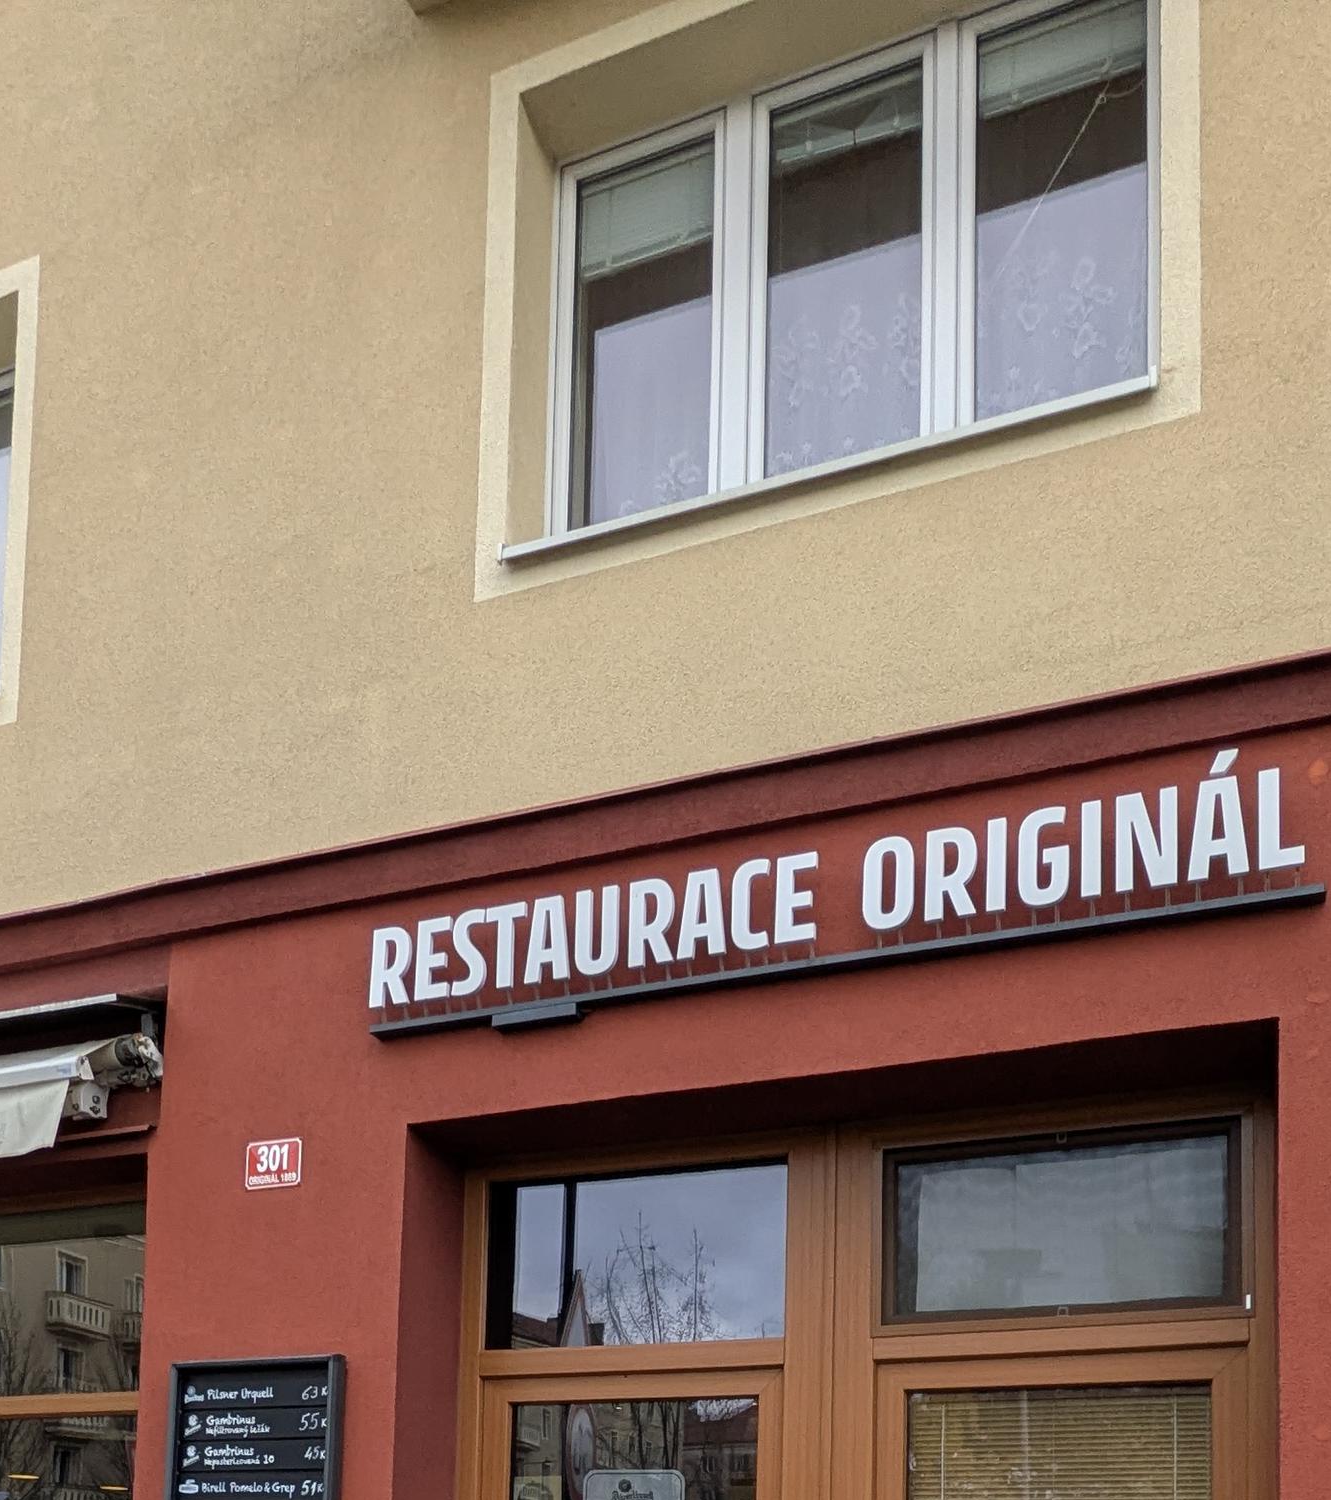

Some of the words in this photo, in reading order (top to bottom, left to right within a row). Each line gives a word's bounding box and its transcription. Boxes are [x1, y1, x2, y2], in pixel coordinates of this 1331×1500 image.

[369, 851, 819, 1008] RESTAURACE
[861, 748, 1306, 933] ORIGINÁL
[256, 1144, 289, 1172] 301
[206, 1388, 239, 1400] Pilsner
[241, 1386, 274, 1404] Urquell
[301, 1386, 319, 1400] 63
[205, 1412, 256, 1426] Gambrinus
[298, 1413, 320, 1431] 55
[204, 1444, 254, 1457] Gambrinus
[304, 1445, 320, 1460] 45
[263, 1454, 275, 1465] 10
[201, 1481, 226, 1493] Birell
[271, 1481, 296, 1498] Grep
[300, 1479, 317, 1496] 51
